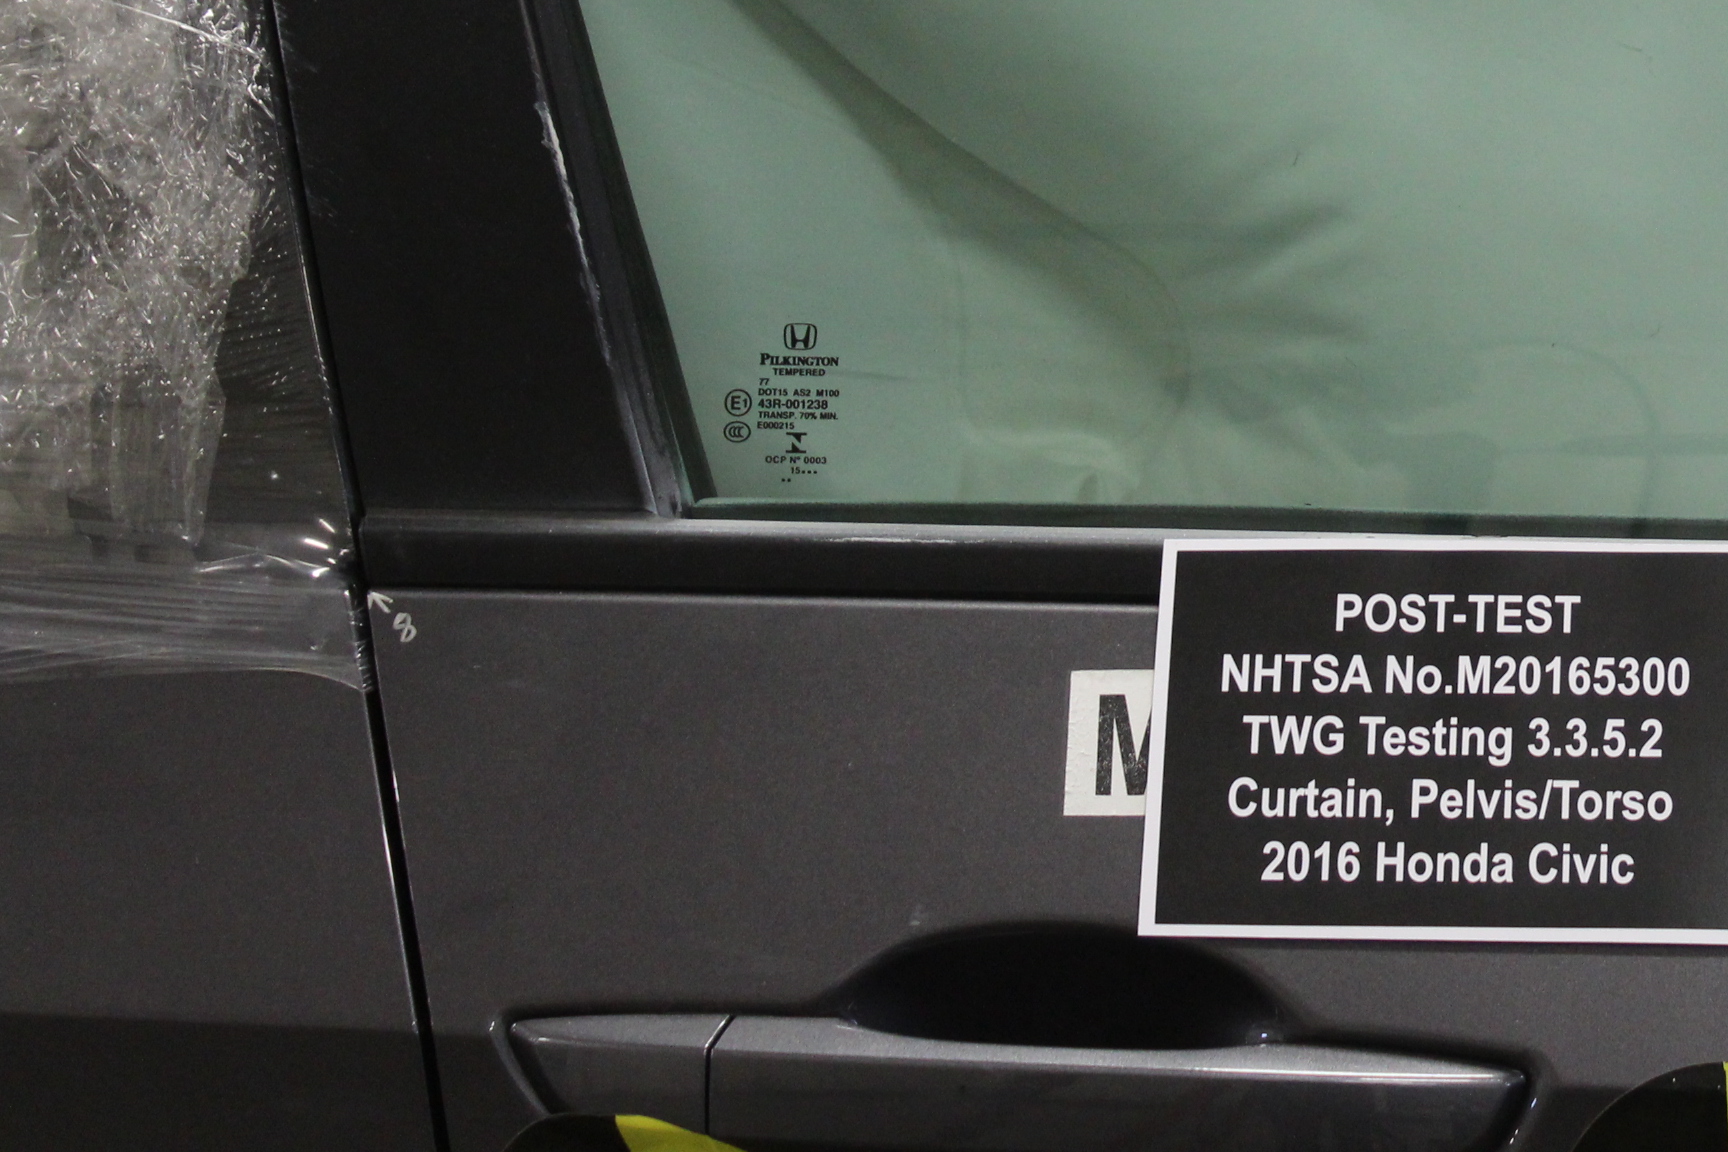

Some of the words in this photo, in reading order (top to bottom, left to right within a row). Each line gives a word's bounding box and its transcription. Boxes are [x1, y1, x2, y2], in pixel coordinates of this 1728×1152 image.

[760, 353, 839, 366] PILKINGTON
[773, 368, 825, 376] TEMPERED
[759, 378, 769, 386] 77
[793, 389, 811, 397] AS2
[816, 389, 839, 397] M100
[758, 400, 828, 409] 43R-001238
[800, 412, 817, 420] 70%
[765, 456, 786, 464] OCP
[1336, 594, 1581, 633] POST-TEST
[1222, 654, 1372, 693] NHTSA
[1386, 655, 1689, 696] No.M20165300
[1243, 715, 1344, 755] TWG
[1359, 716, 1512, 766] Testing
[1528, 718, 1662, 757] 3.3.5.2
[1229, 777, 1393, 826] Curtain,
[1411, 779, 1672, 820] Pelvis/Torso
[1261, 841, 1360, 881] 2016
[1377, 842, 1513, 883] Honda
[1529, 843, 1634, 884] Civic
